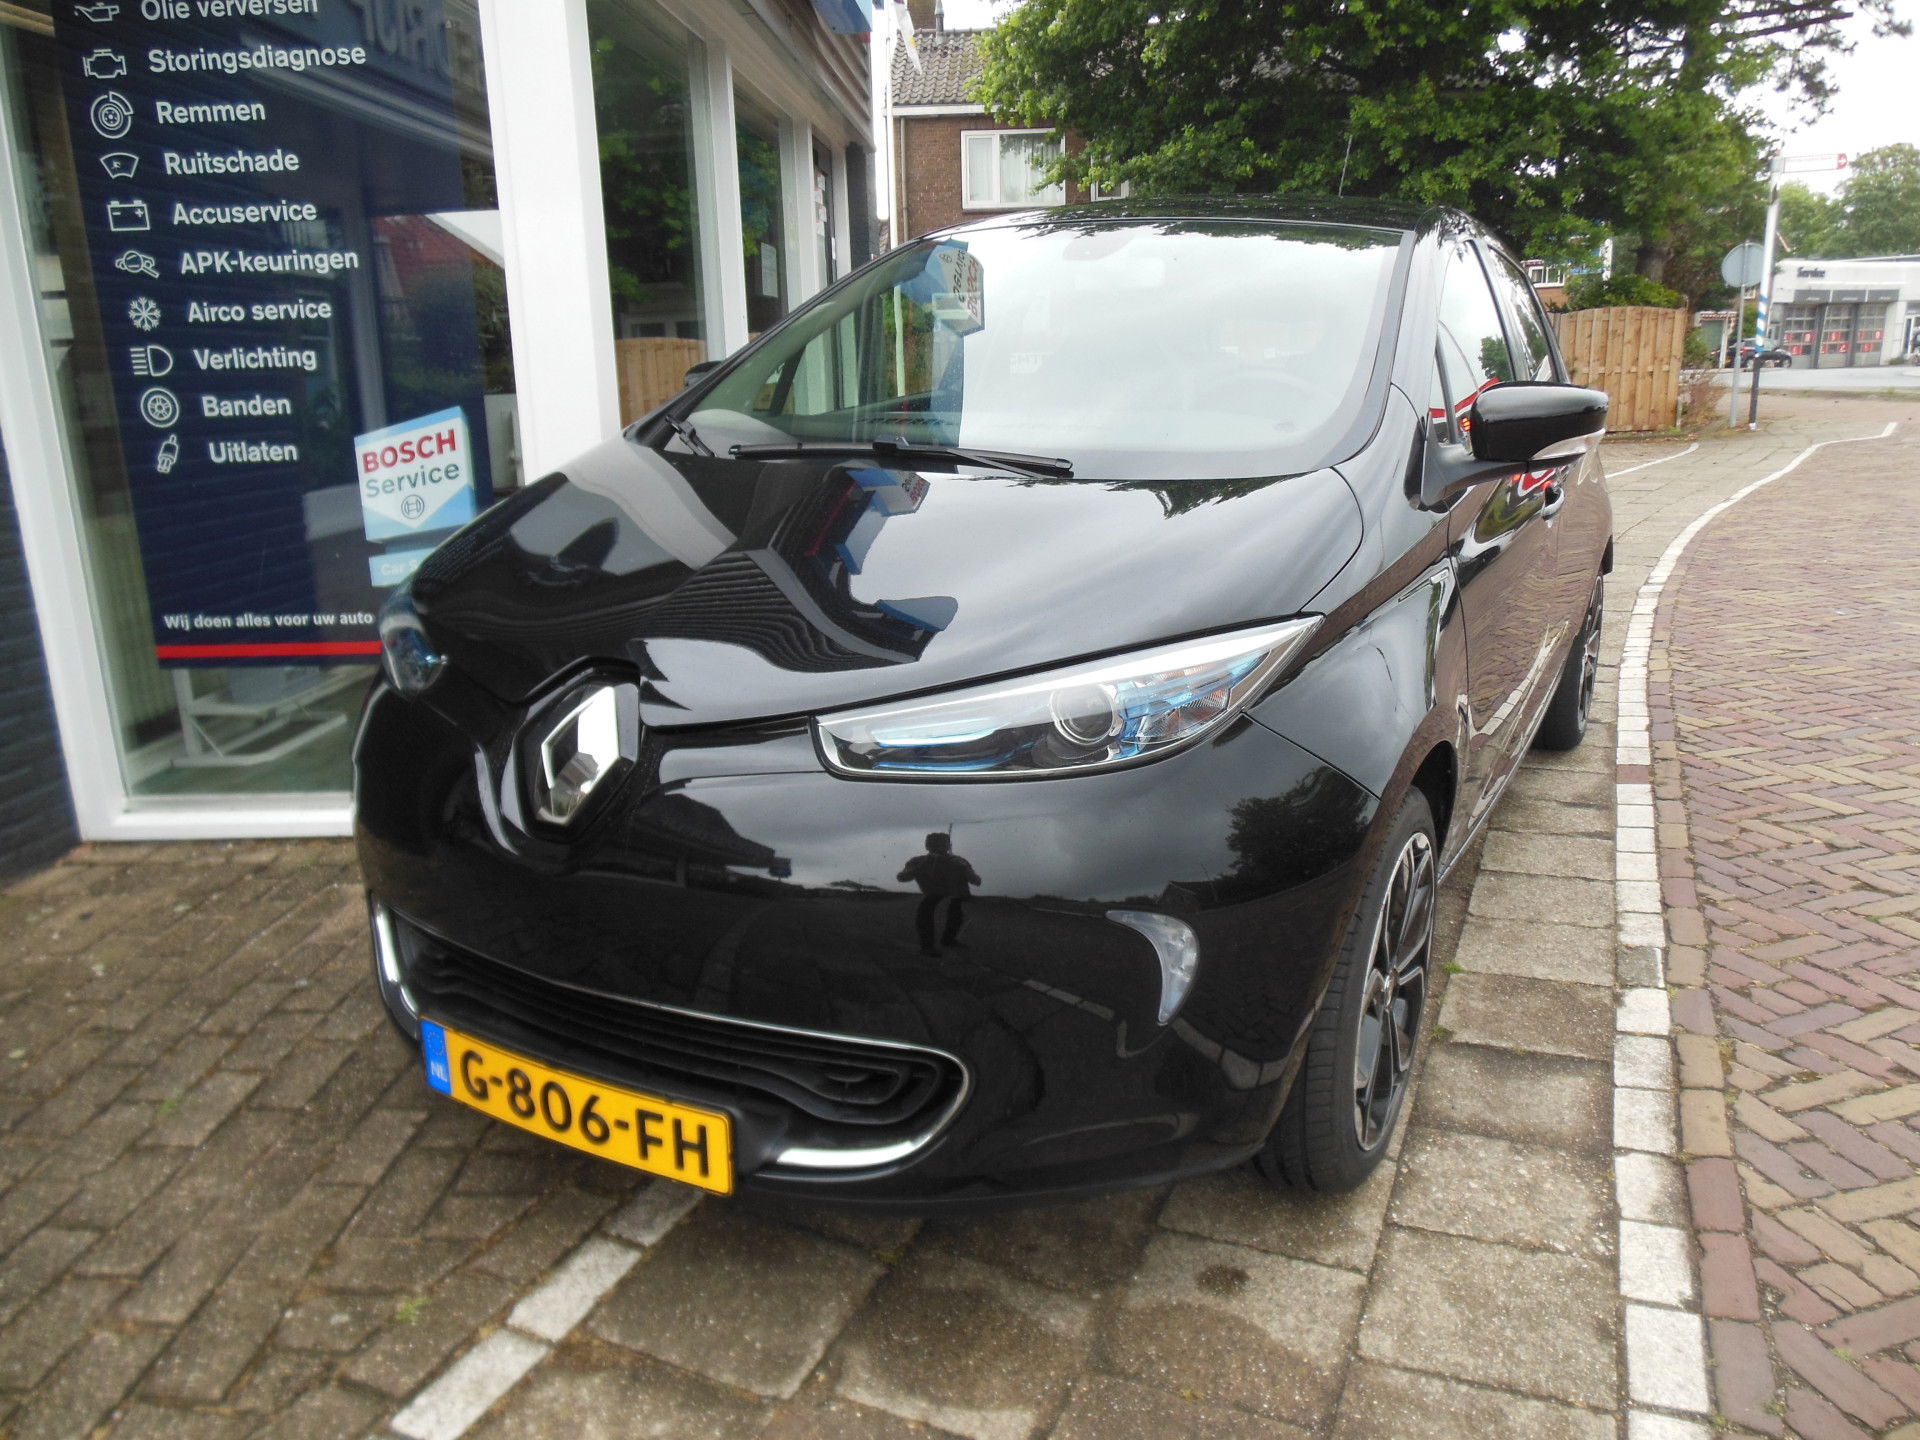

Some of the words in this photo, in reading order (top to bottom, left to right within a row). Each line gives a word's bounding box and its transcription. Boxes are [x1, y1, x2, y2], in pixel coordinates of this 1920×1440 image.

[140, 0, 191, 20] Olie
[196, 0, 318, 17] verversen
[148, 44, 366, 73] Storingsdiagnose
[156, 100, 266, 124] Remmen
[164, 149, 300, 175] Ruitschade
[173, 201, 318, 225] Accuservice
[180, 249, 359, 275] APK-keuringen
[188, 302, 246, 323] Airco
[252, 299, 332, 321] service
[193, 347, 318, 372] Verlichting
[202, 394, 292, 418] Banden
[209, 440, 298, 463] Uitlaten
[362, 429, 457, 474] BOSCH
[365, 459, 460, 499] Service
[164, 613, 190, 631] Wij
[194, 613, 232, 628] doen
[236, 612, 270, 627] alles
[274, 614, 308, 626] voor
[312, 614, 335, 625] uw
[340, 611, 373, 625] auto
[431, 1061, 447, 1082] NL
[460, 1048, 709, 1178] G-806-FH
